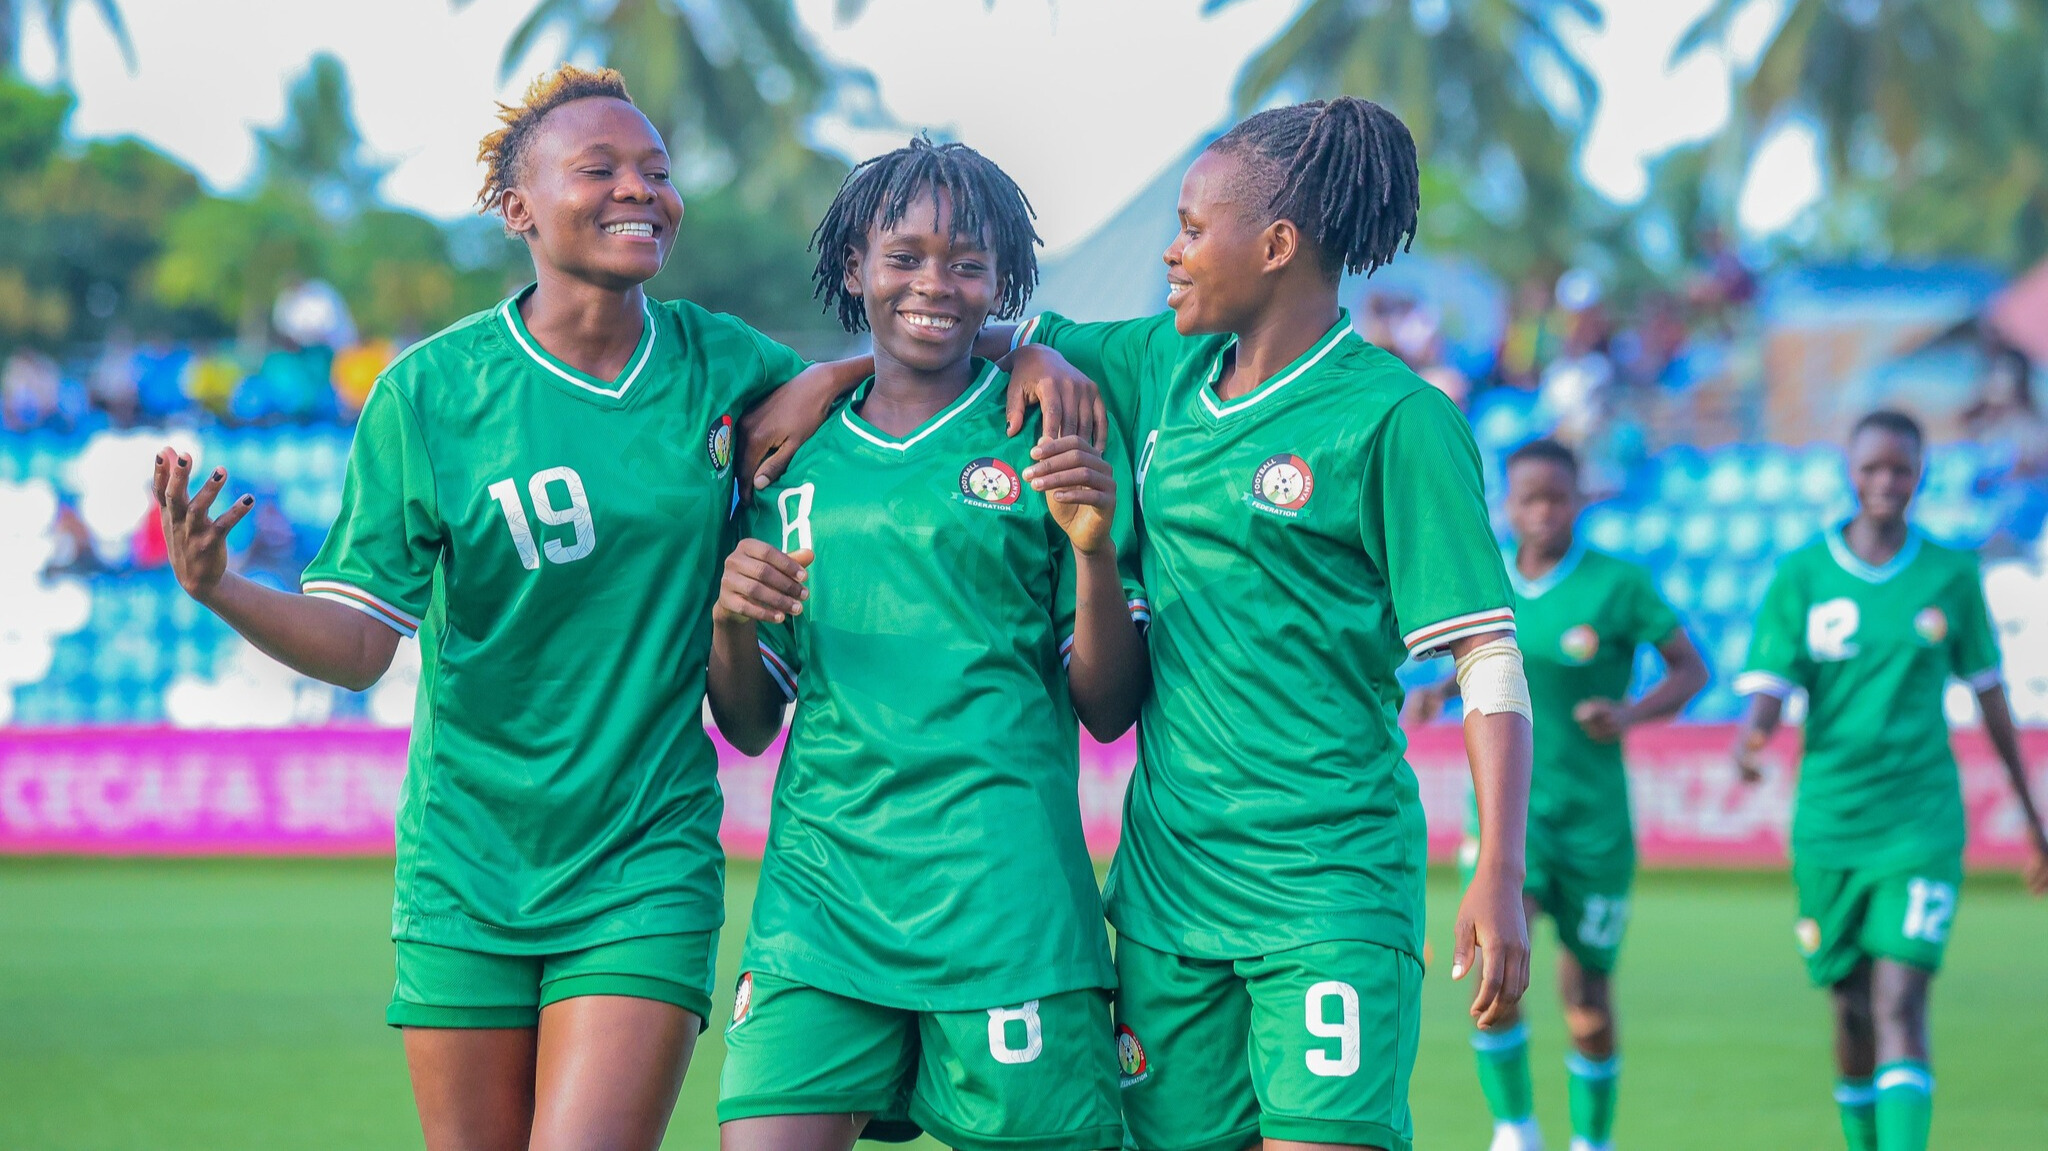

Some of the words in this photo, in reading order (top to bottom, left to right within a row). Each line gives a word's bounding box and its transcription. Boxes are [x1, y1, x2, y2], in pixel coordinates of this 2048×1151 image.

[961, 462, 979, 493] FOOTBALL
[1254, 458, 1277, 494] FOOTBALL
[1299, 475, 1311, 501] KENYA
[488, 466, 596, 570] 19
[963, 498, 1011, 511] FEDERATION
[1252, 500, 1297, 517] FEDERATION
[1903, 877, 1956, 943] 12
[986, 999, 1043, 1064] 8
[1305, 980, 1360, 1077] 9
